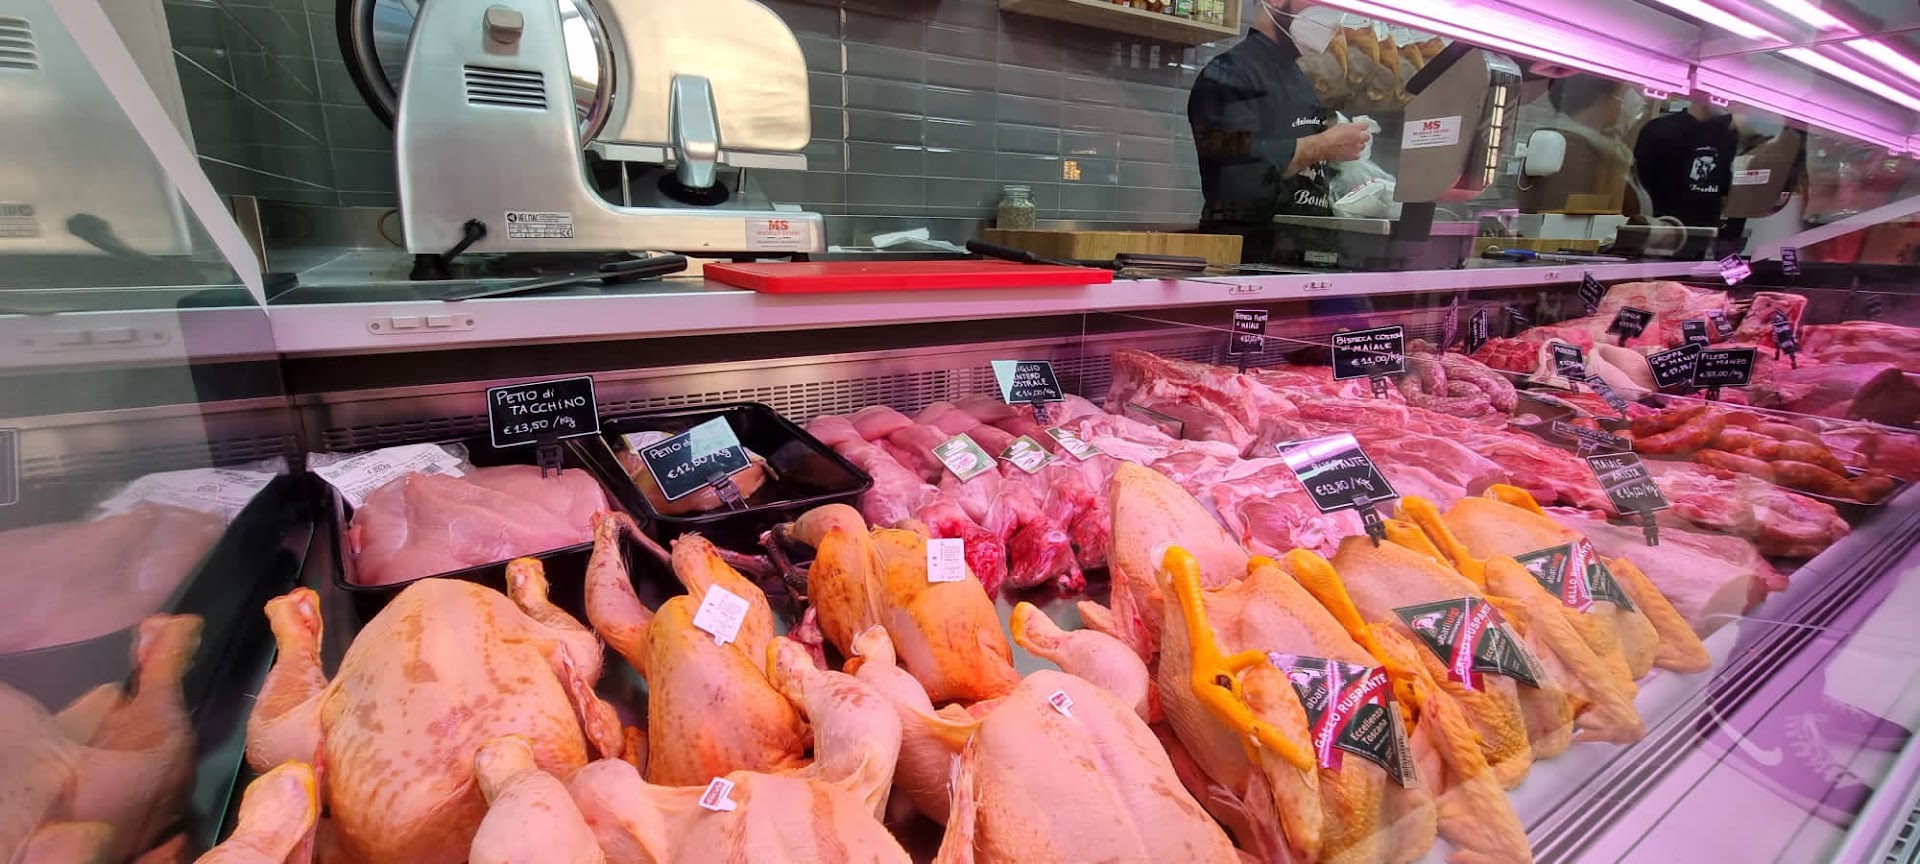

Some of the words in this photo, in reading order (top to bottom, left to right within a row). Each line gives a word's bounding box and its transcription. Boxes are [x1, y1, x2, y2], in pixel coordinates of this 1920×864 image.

[1422, 120, 1442, 130] MS
[767, 219, 789, 231] MS
[1336, 335, 1373, 346] BISTECCA
[1353, 341, 1392, 351] MAIALE
[496, 390, 538, 406] PETTO
[542, 388, 555, 399] di
[508, 396, 586, 416] TACCHINO
[503, 419, 549, 435] €13,50
[649, 442, 682, 460] PETTO
[1591, 458, 1623, 471] MAIALE
[1612, 467, 1641, 482] ARISTA
[1567, 578, 1578, 605] GALLO
[1313, 712, 1341, 749] GALLO
[1337, 673, 1388, 714] RUSPANTE
[1349, 707, 1385, 742] Eccellenza
[1361, 718, 1388, 745] Toscana
